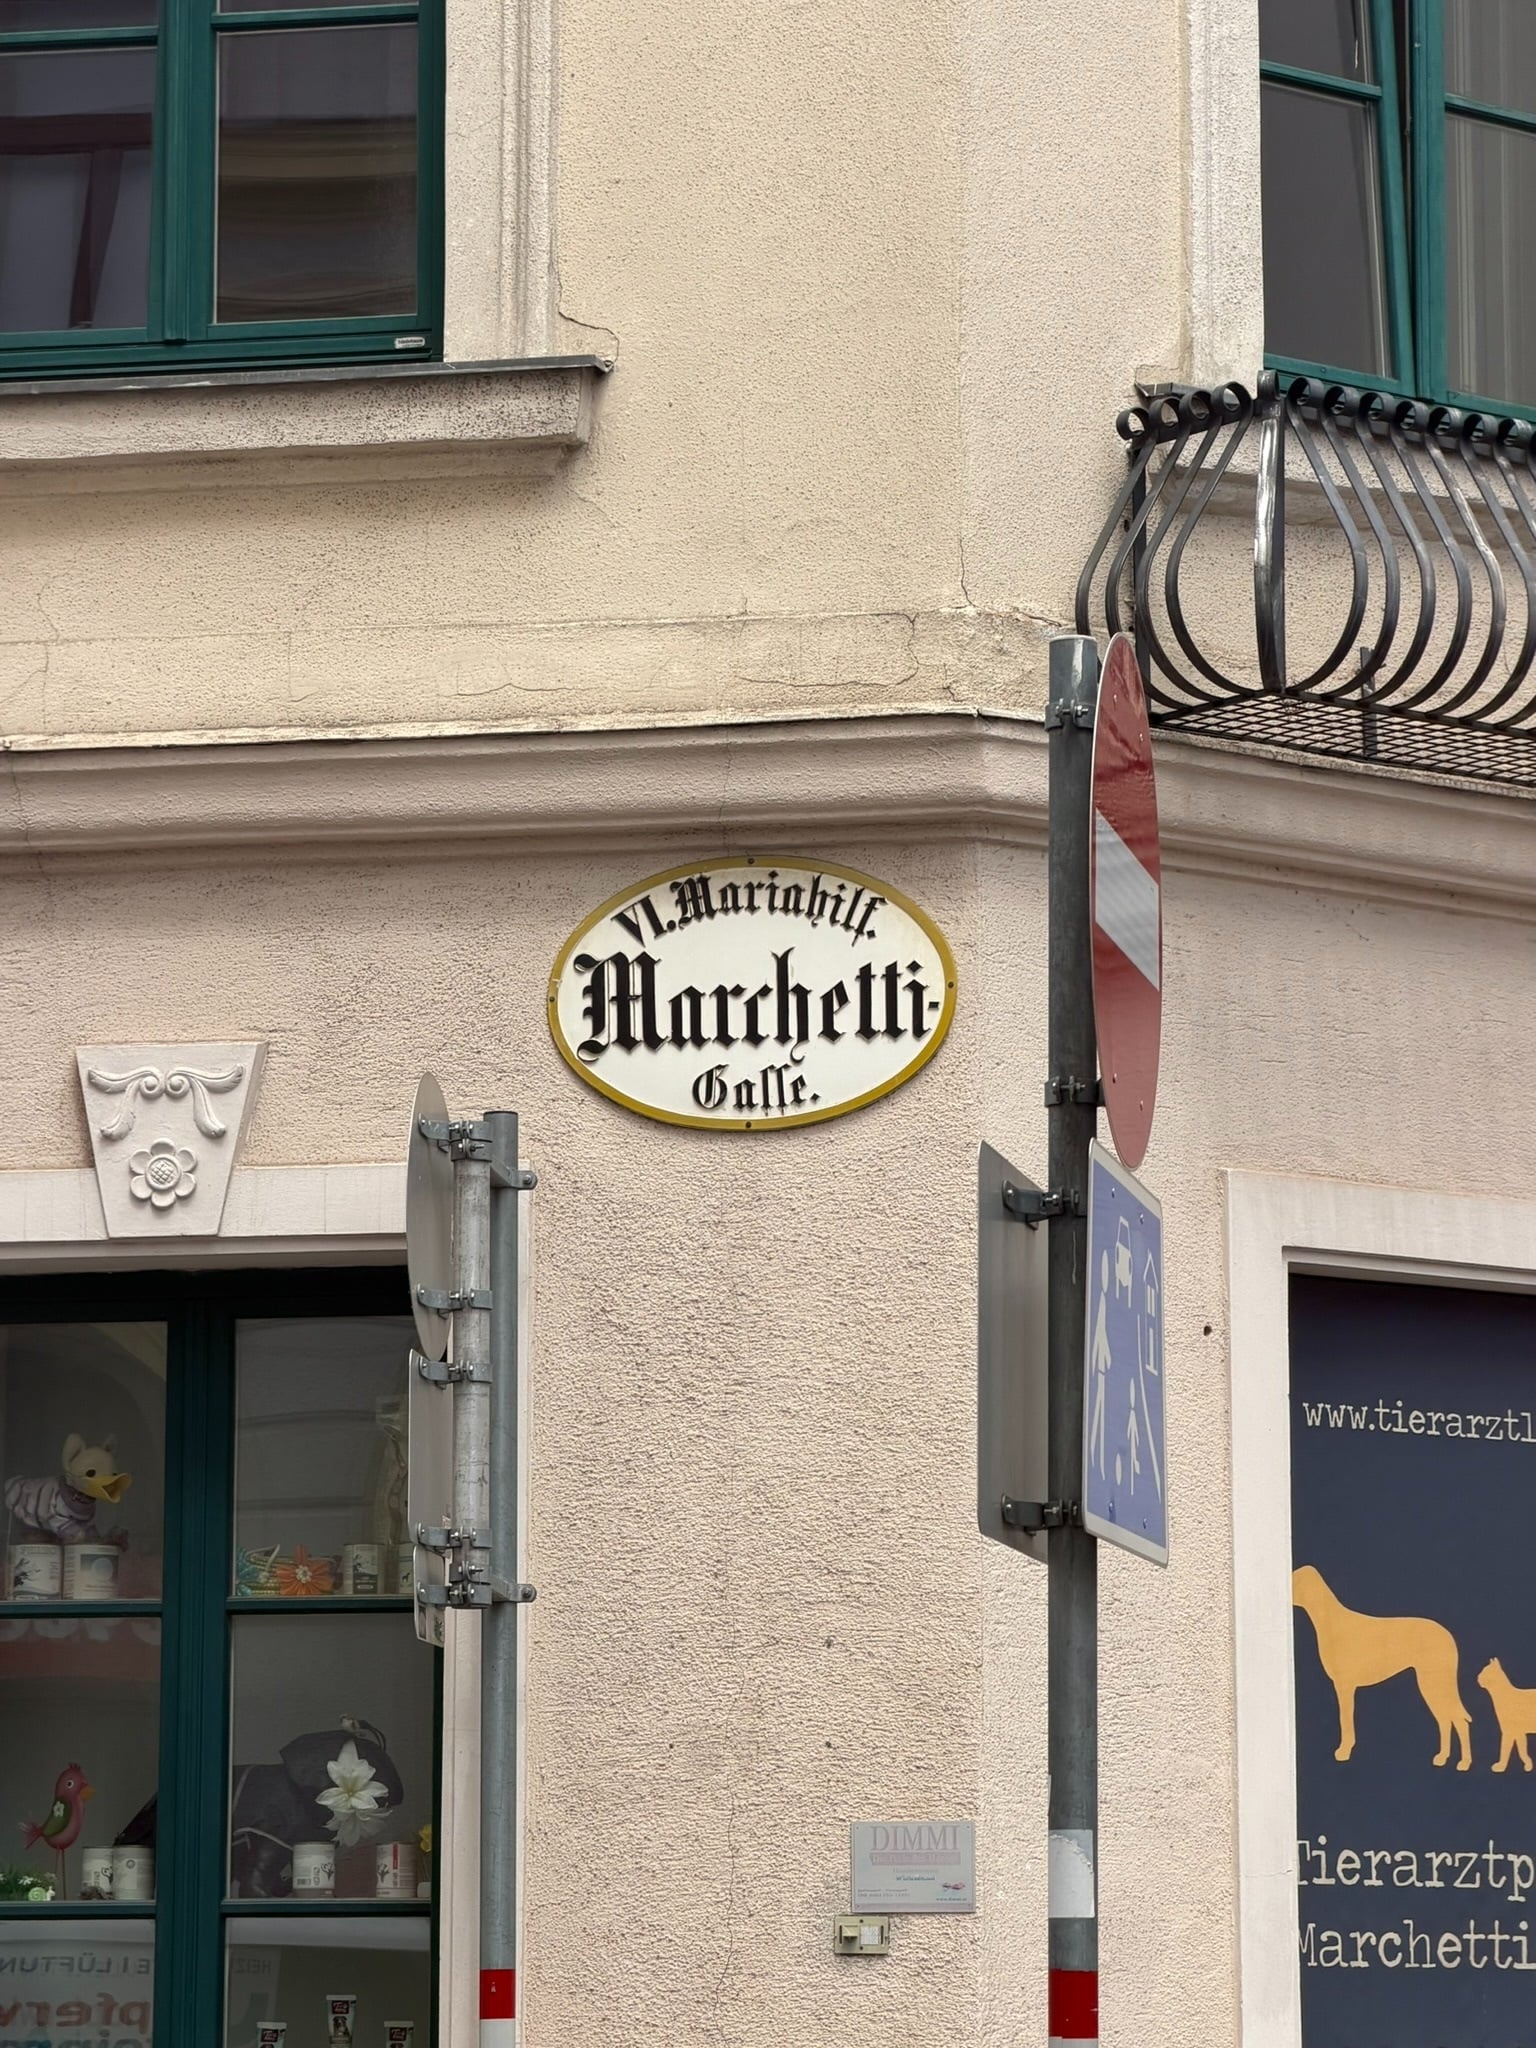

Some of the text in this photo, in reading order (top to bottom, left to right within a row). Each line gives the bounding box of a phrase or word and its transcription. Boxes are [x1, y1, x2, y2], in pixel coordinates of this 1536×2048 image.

[1302, 1399, 1536, 1443] www.tierarztl
[870, 1825, 960, 1851] DIMMI
[1299, 1919, 1536, 1970] Marchetti
